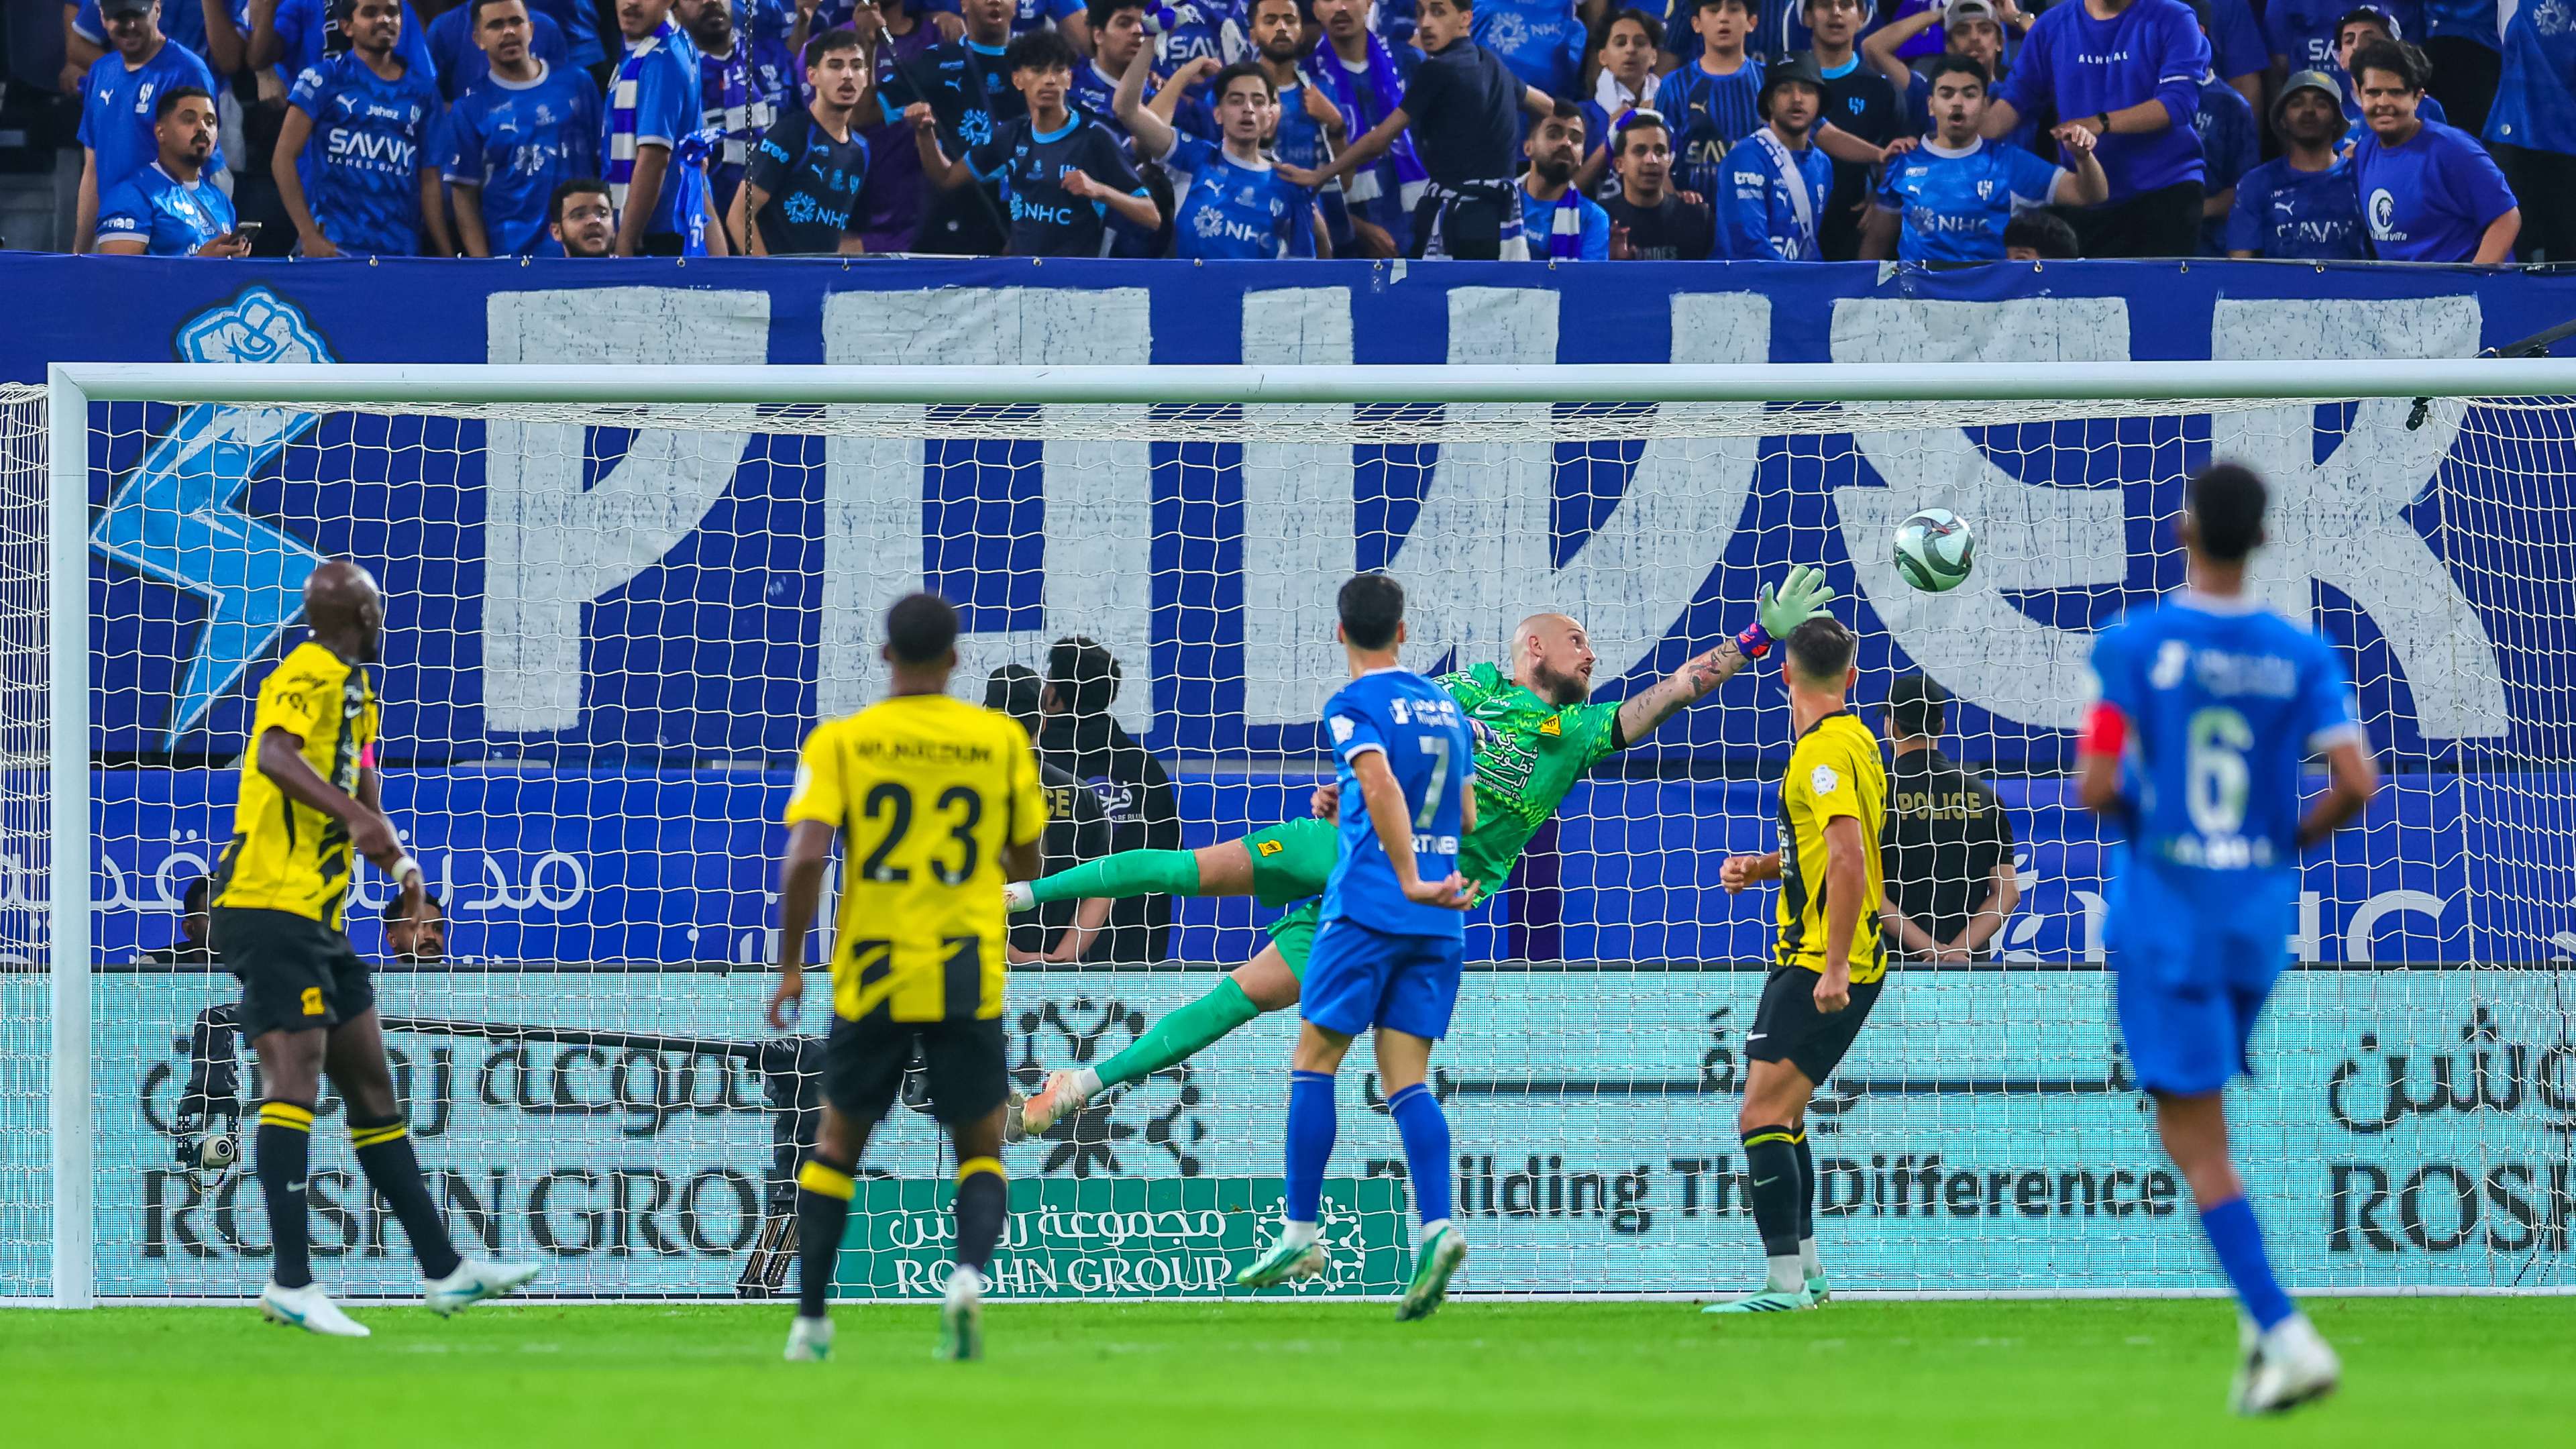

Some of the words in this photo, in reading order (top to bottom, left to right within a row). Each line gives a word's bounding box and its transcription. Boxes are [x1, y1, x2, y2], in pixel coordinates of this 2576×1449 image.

[1169, 36, 1220, 59] SAV
[328, 127, 416, 167] SAVVY
[1025, 203, 1072, 225] NHC
[482, 285, 2510, 739] POWER
[1415, 735, 1450, 828] 7
[2185, 706, 2255, 840] 6
[862, 782, 982, 885] 23
[1897, 792, 1983, 820] POLICE
[528, 1168, 902, 1258] GRO
[1366, 1155, 1649, 1233] ilding
[1672, 1155, 1754, 1218] Th
[1820, 1154, 2177, 1217] Difference
[1038, 1205, 1226, 1246] مجموعة
[1067, 1256, 1232, 1293] GROUP
